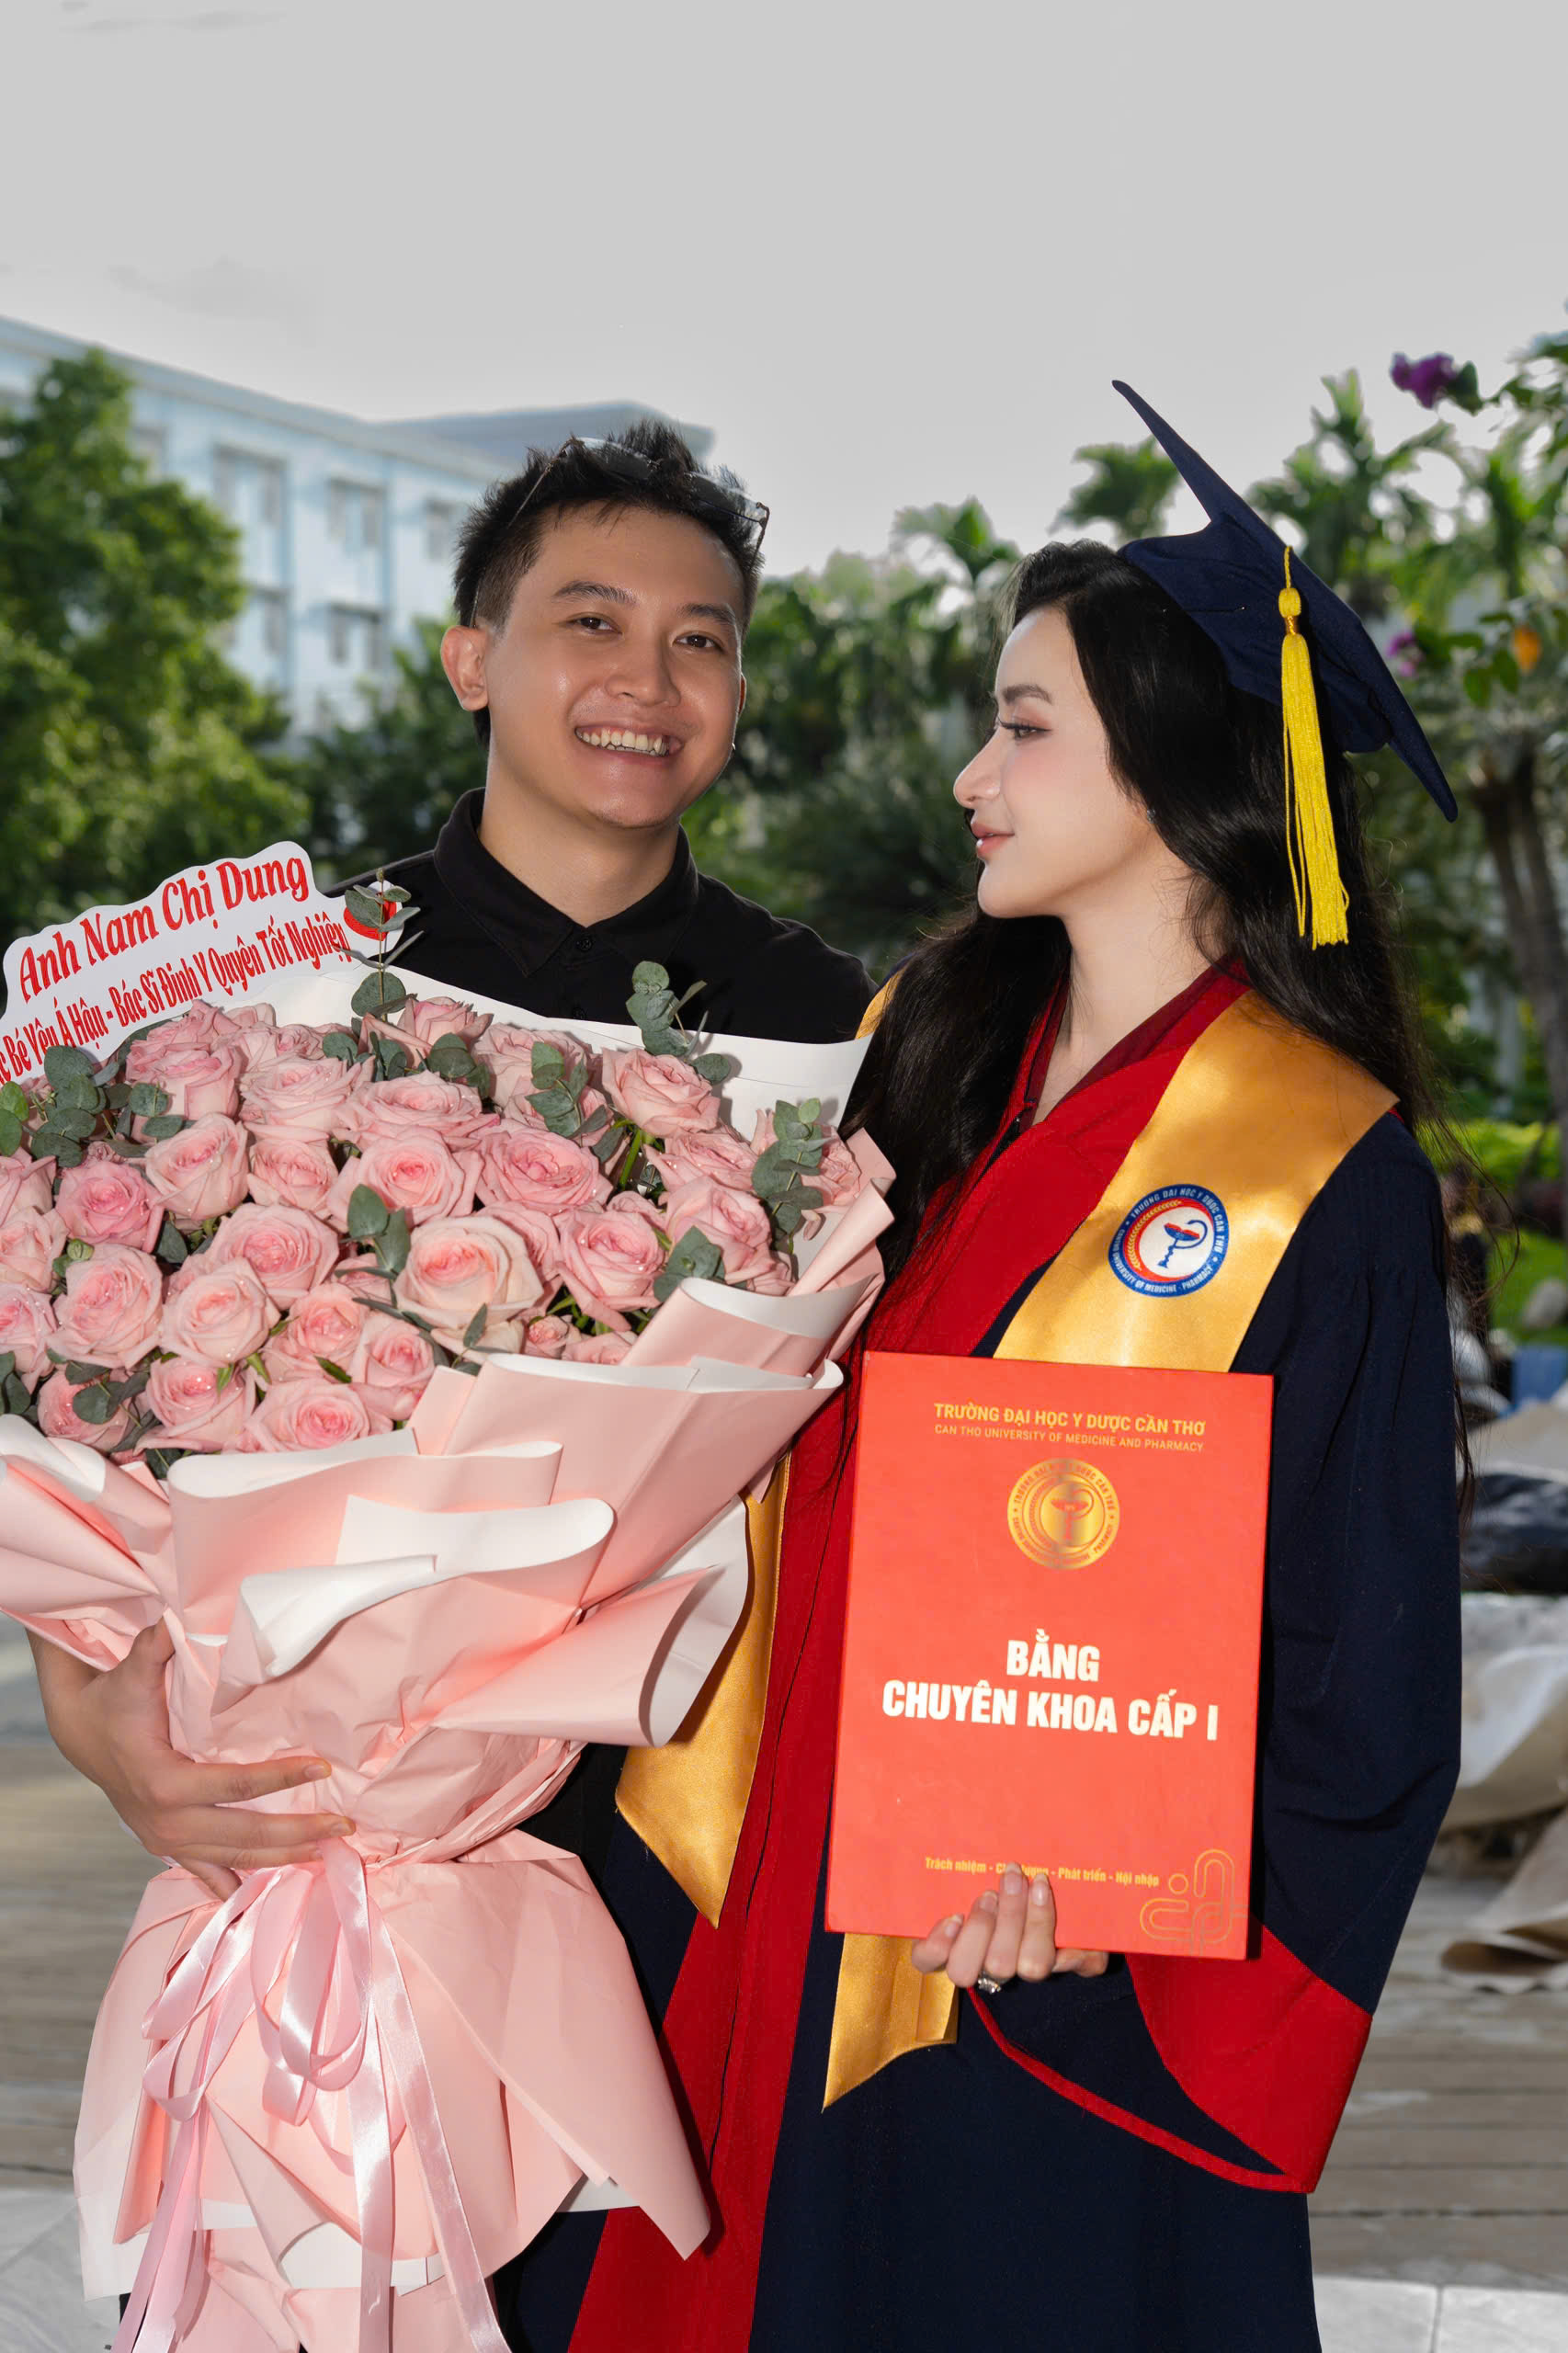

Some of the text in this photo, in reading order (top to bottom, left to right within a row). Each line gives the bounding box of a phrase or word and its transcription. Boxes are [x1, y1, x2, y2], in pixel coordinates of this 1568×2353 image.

[19, 857, 311, 1004] Anh Nam Chị Dung
[256, 915, 294, 971] Tốt
[284, 911, 352, 971] Nghiệp
[155, 958, 202, 1008] Đinh
[192, 951, 212, 993] Y
[208, 935, 266, 996] Quyên
[106, 1010, 114, 1019] -
[108, 979, 148, 1028] Bác
[140, 970, 165, 1014] Sĩ
[23, 1017, 55, 1065] Yêu
[53, 996, 76, 1048] Á
[66, 996, 109, 1050] Hậu
[3, 1028, 32, 1077] Bé
[934, 1402, 1206, 1436] TRƯỜNG ĐẠI HỌC Y DƯỢC CẦN THƠ
[935, 1424, 1204, 1452] CAN THO UNIVERSITY OF MEDICINE AND PHARMACY
[1006, 1628, 1101, 1682] BẰNG
[881, 1679, 1219, 1741] CHUYÊN KHOA CẤP I
[926, 1856, 952, 1870] Trách
[955, 1859, 986, 1875] nhiệm
[1058, 1867, 1081, 1881] Phát
[1116, 1870, 1132, 1885] Hội
[1134, 1872, 1159, 1888] nhập
